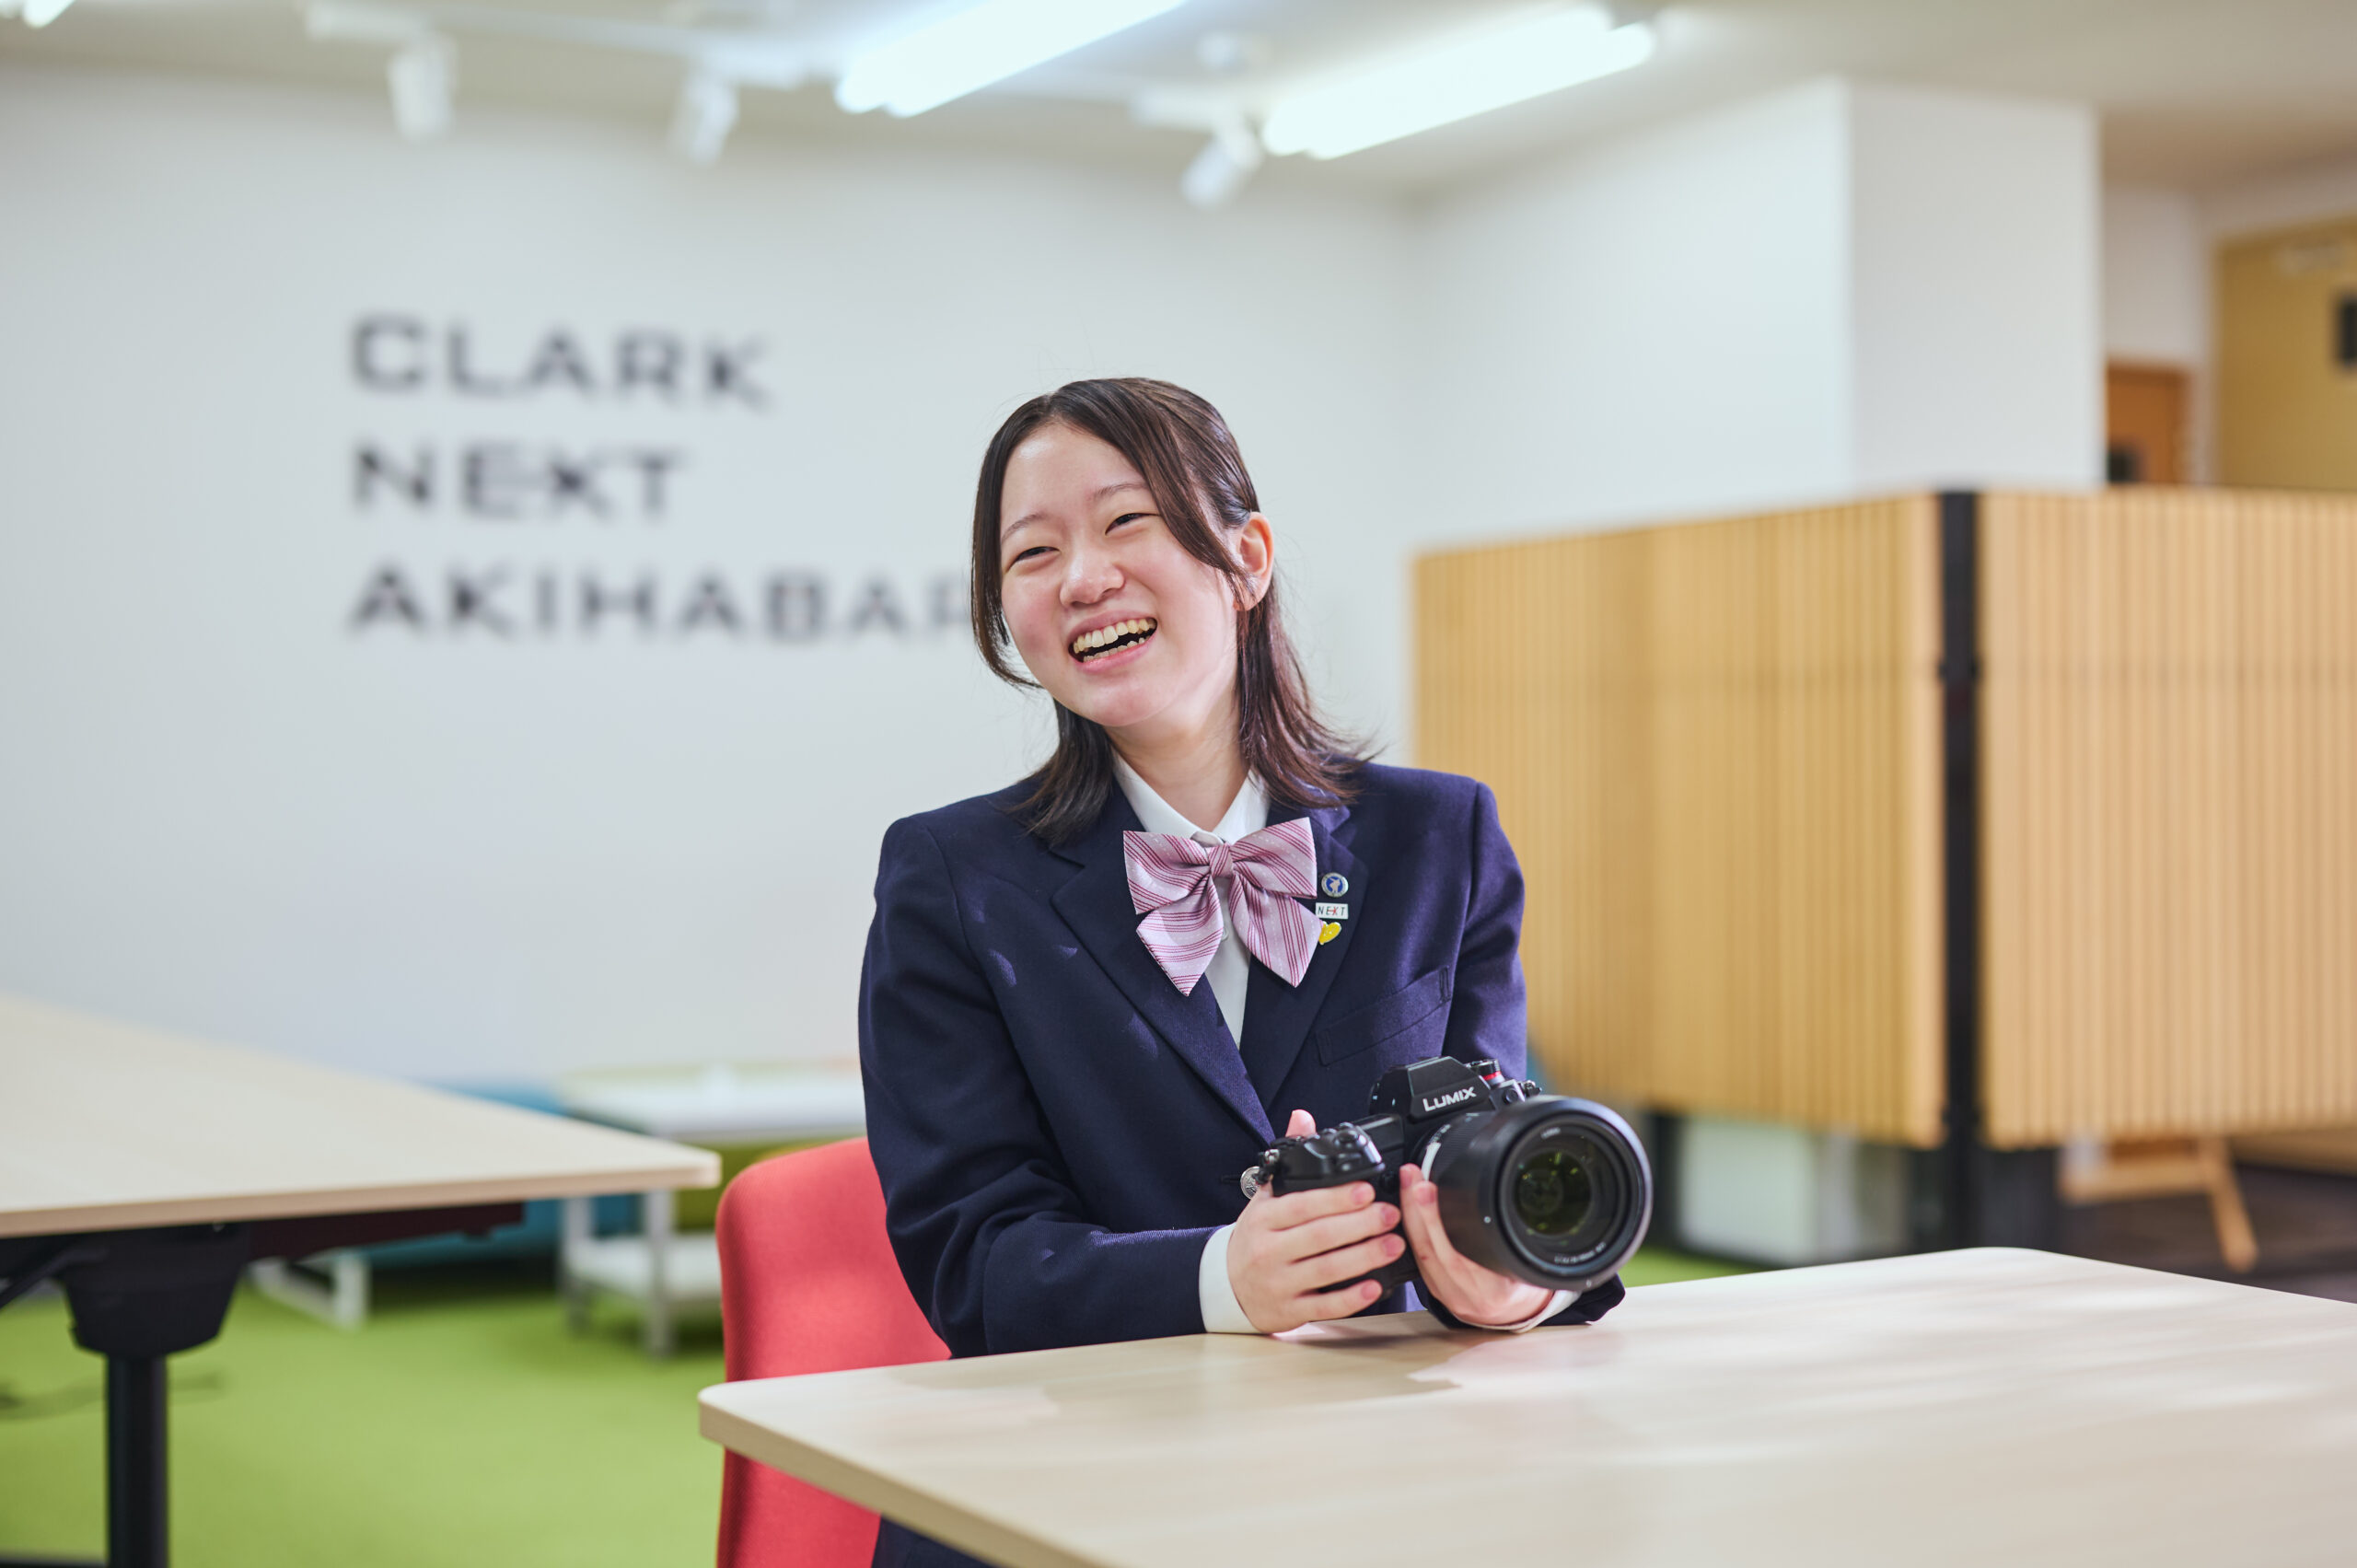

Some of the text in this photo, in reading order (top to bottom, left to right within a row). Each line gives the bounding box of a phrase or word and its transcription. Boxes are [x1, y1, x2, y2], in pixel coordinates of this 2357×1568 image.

[351, 314, 773, 412] CLARK
[352, 442, 685, 517] NEXT
[1318, 906, 1345, 916] NEXT
[1422, 1086, 1477, 1111] LUMIX
